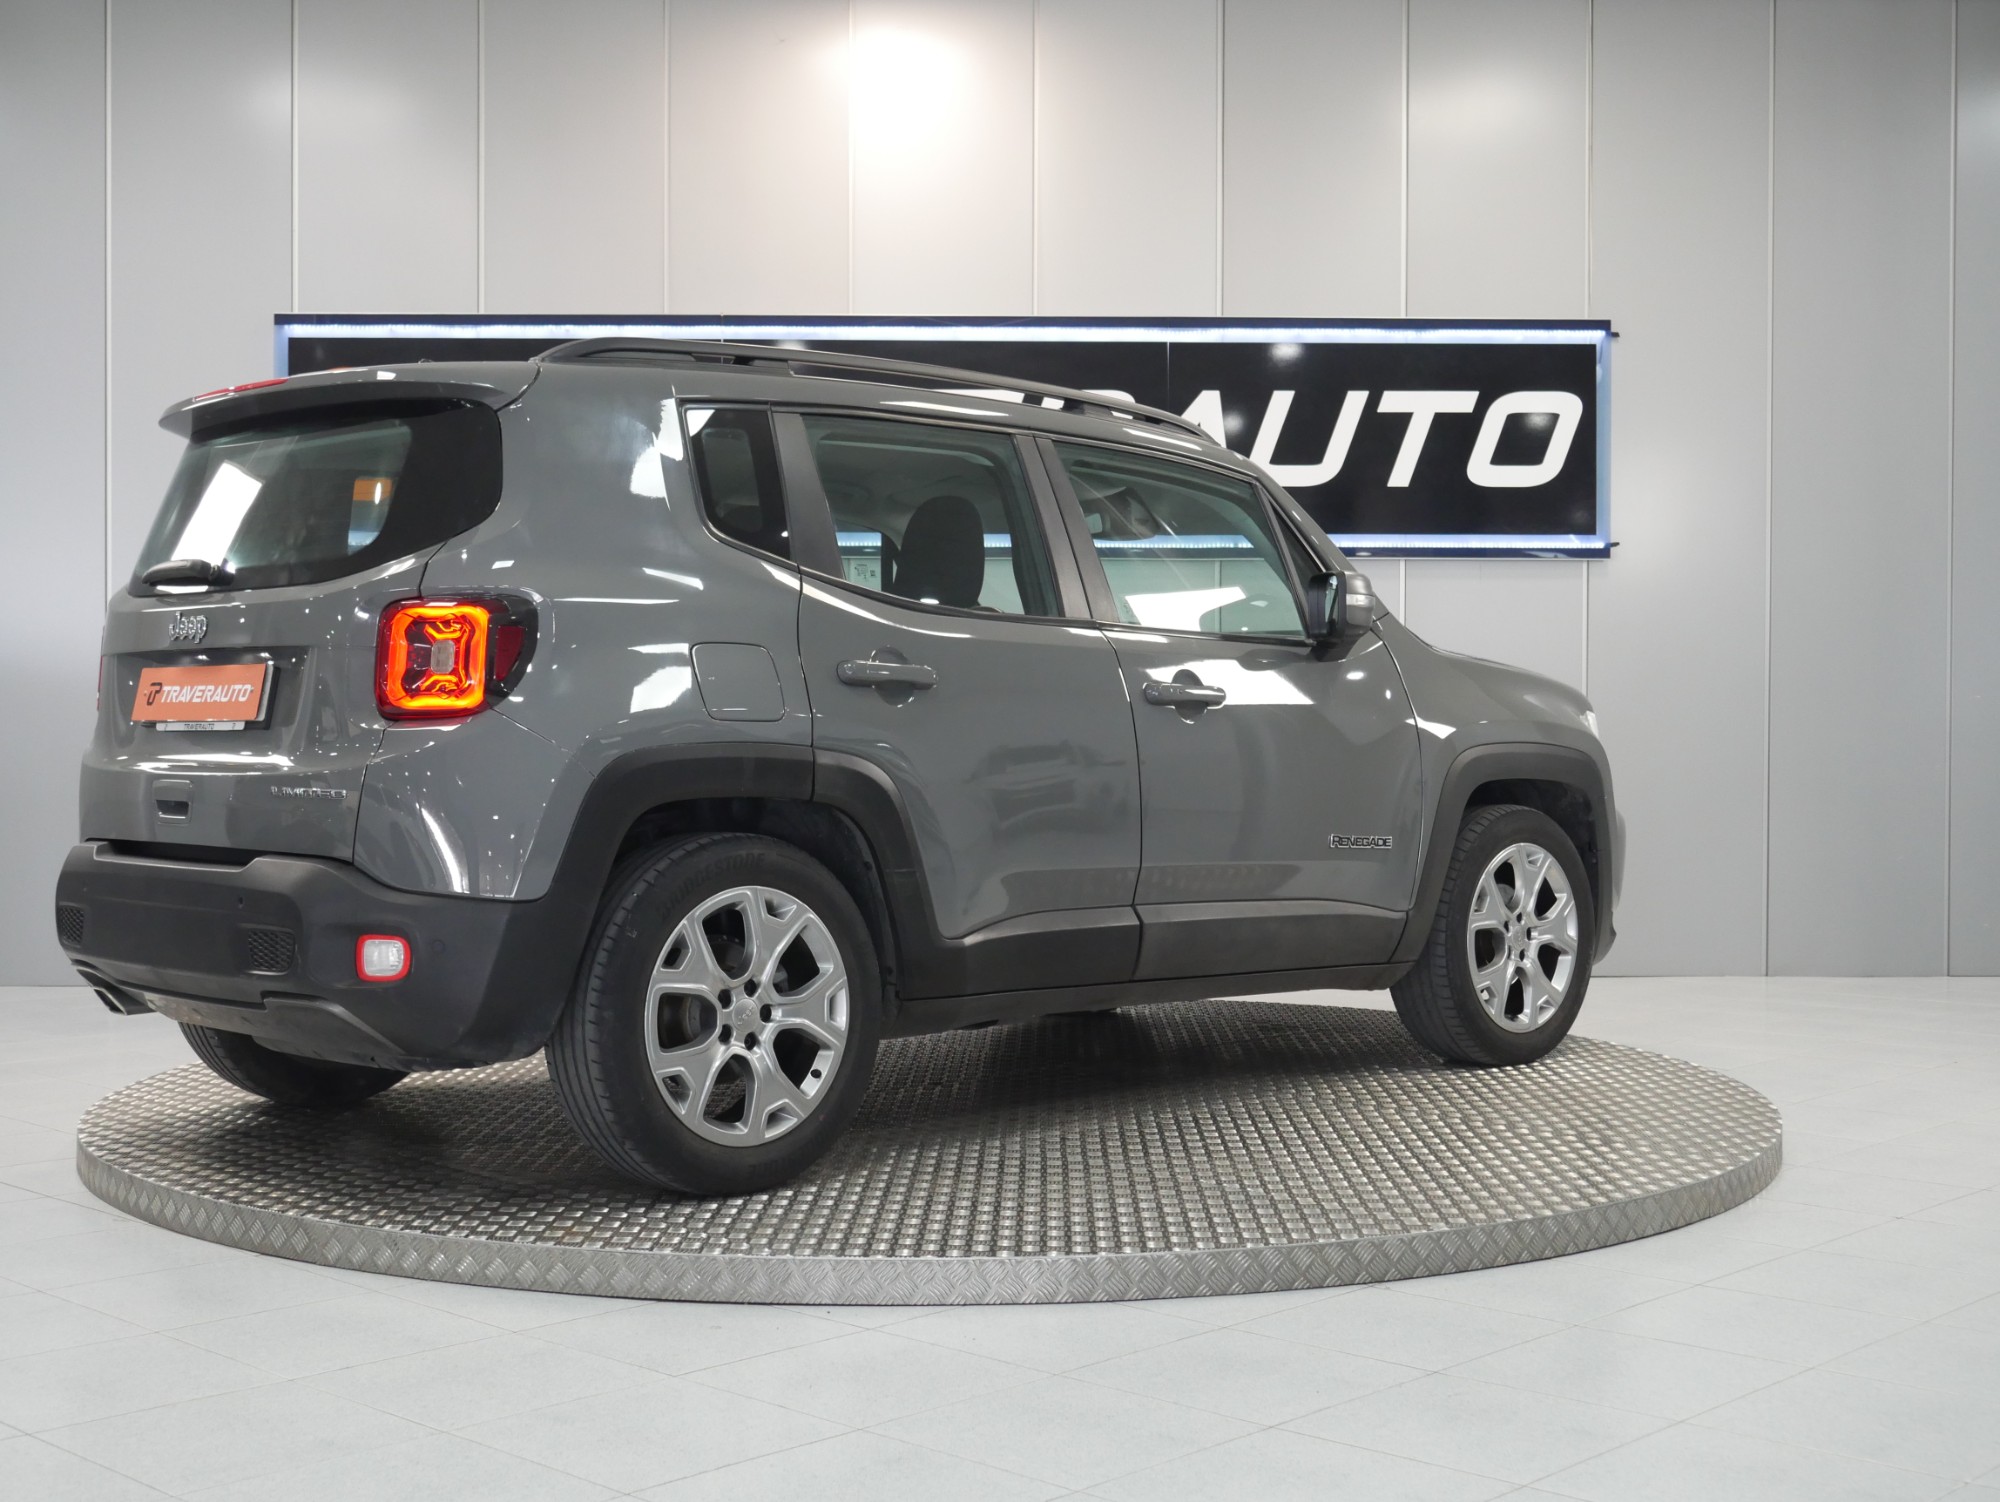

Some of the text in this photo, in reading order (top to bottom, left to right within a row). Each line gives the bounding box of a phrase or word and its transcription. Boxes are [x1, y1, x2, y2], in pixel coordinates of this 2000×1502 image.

[168, 611, 208, 644] Jeep
[161, 684, 252, 703] TRAVERAUTO
[1330, 833, 1393, 849] RENEGADE
